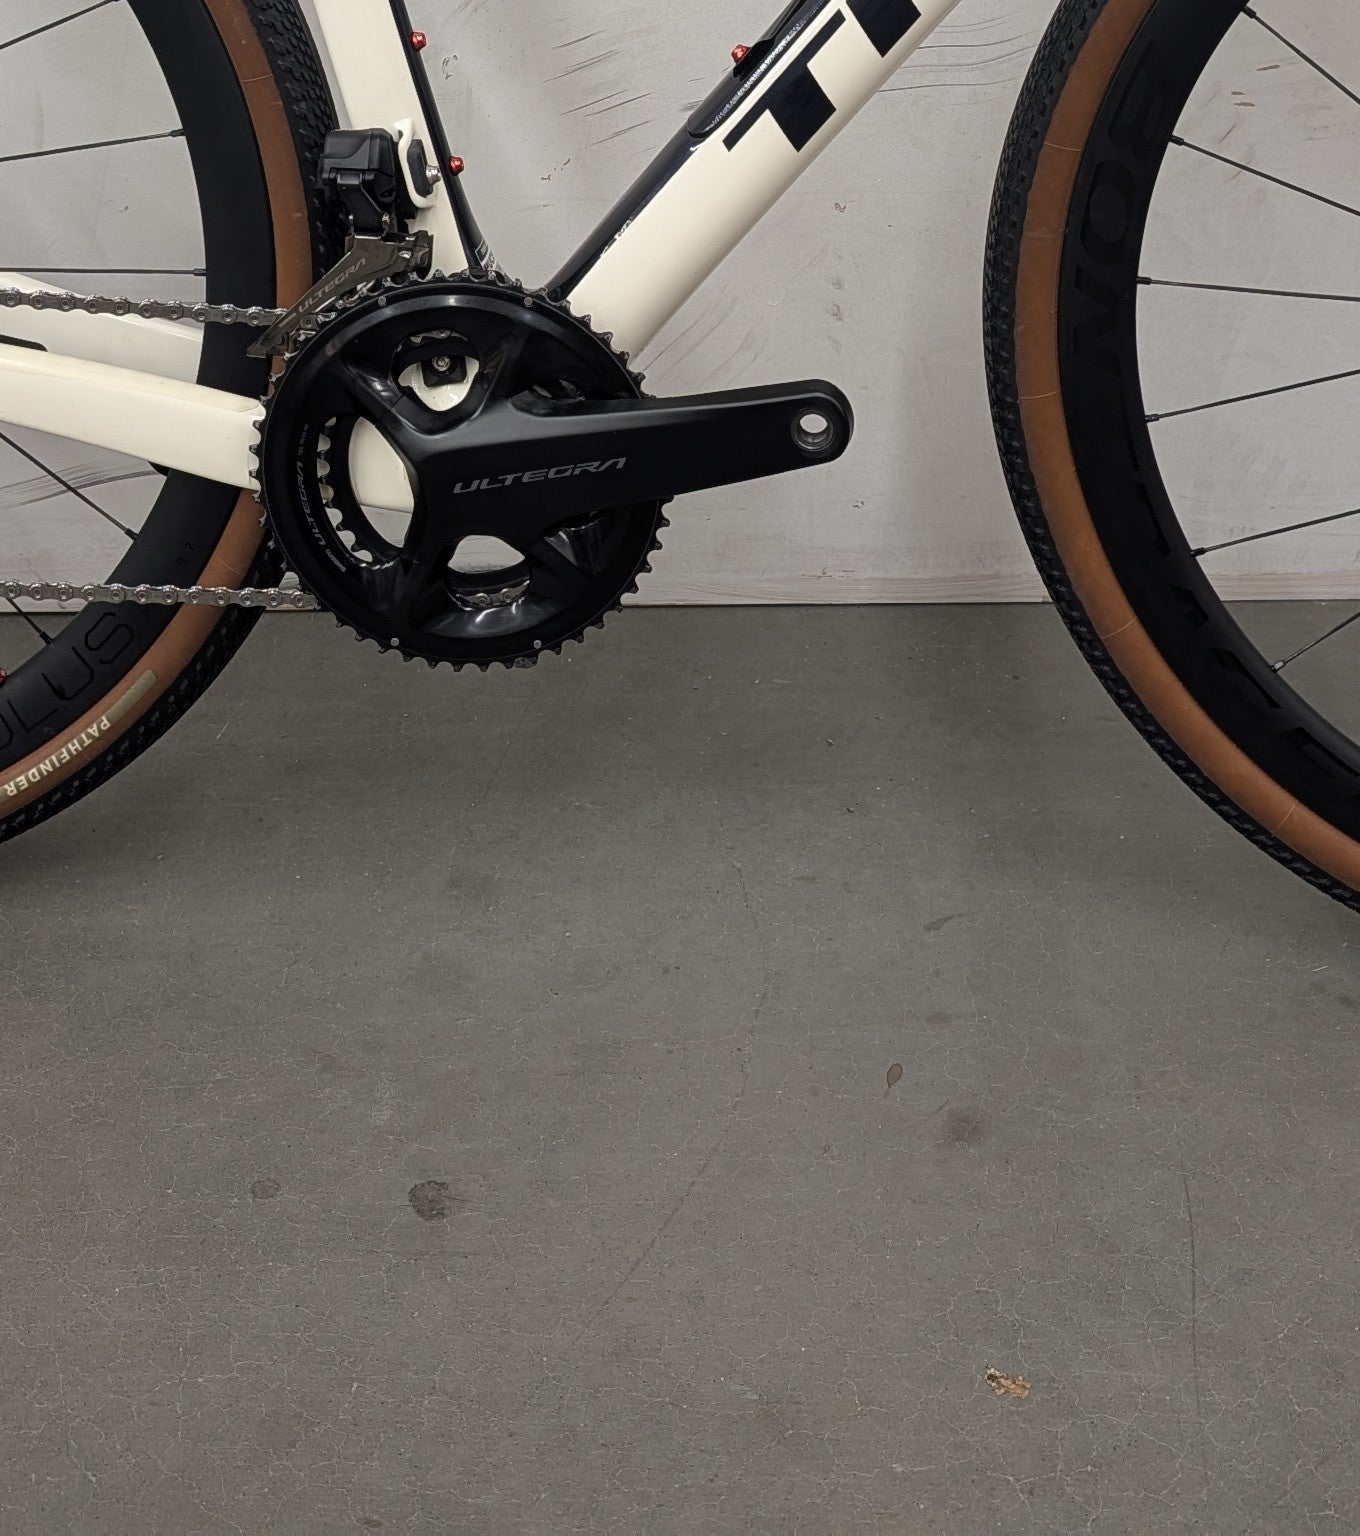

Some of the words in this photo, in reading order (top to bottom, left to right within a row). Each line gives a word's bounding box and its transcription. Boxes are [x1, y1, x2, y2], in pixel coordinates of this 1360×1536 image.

[298, 257, 366, 313] ULTEGRA
[296, 460, 327, 546] ULTEGRA
[451, 456, 628, 495] ULTEGRA
[4, 714, 112, 798] PATHFINDER
